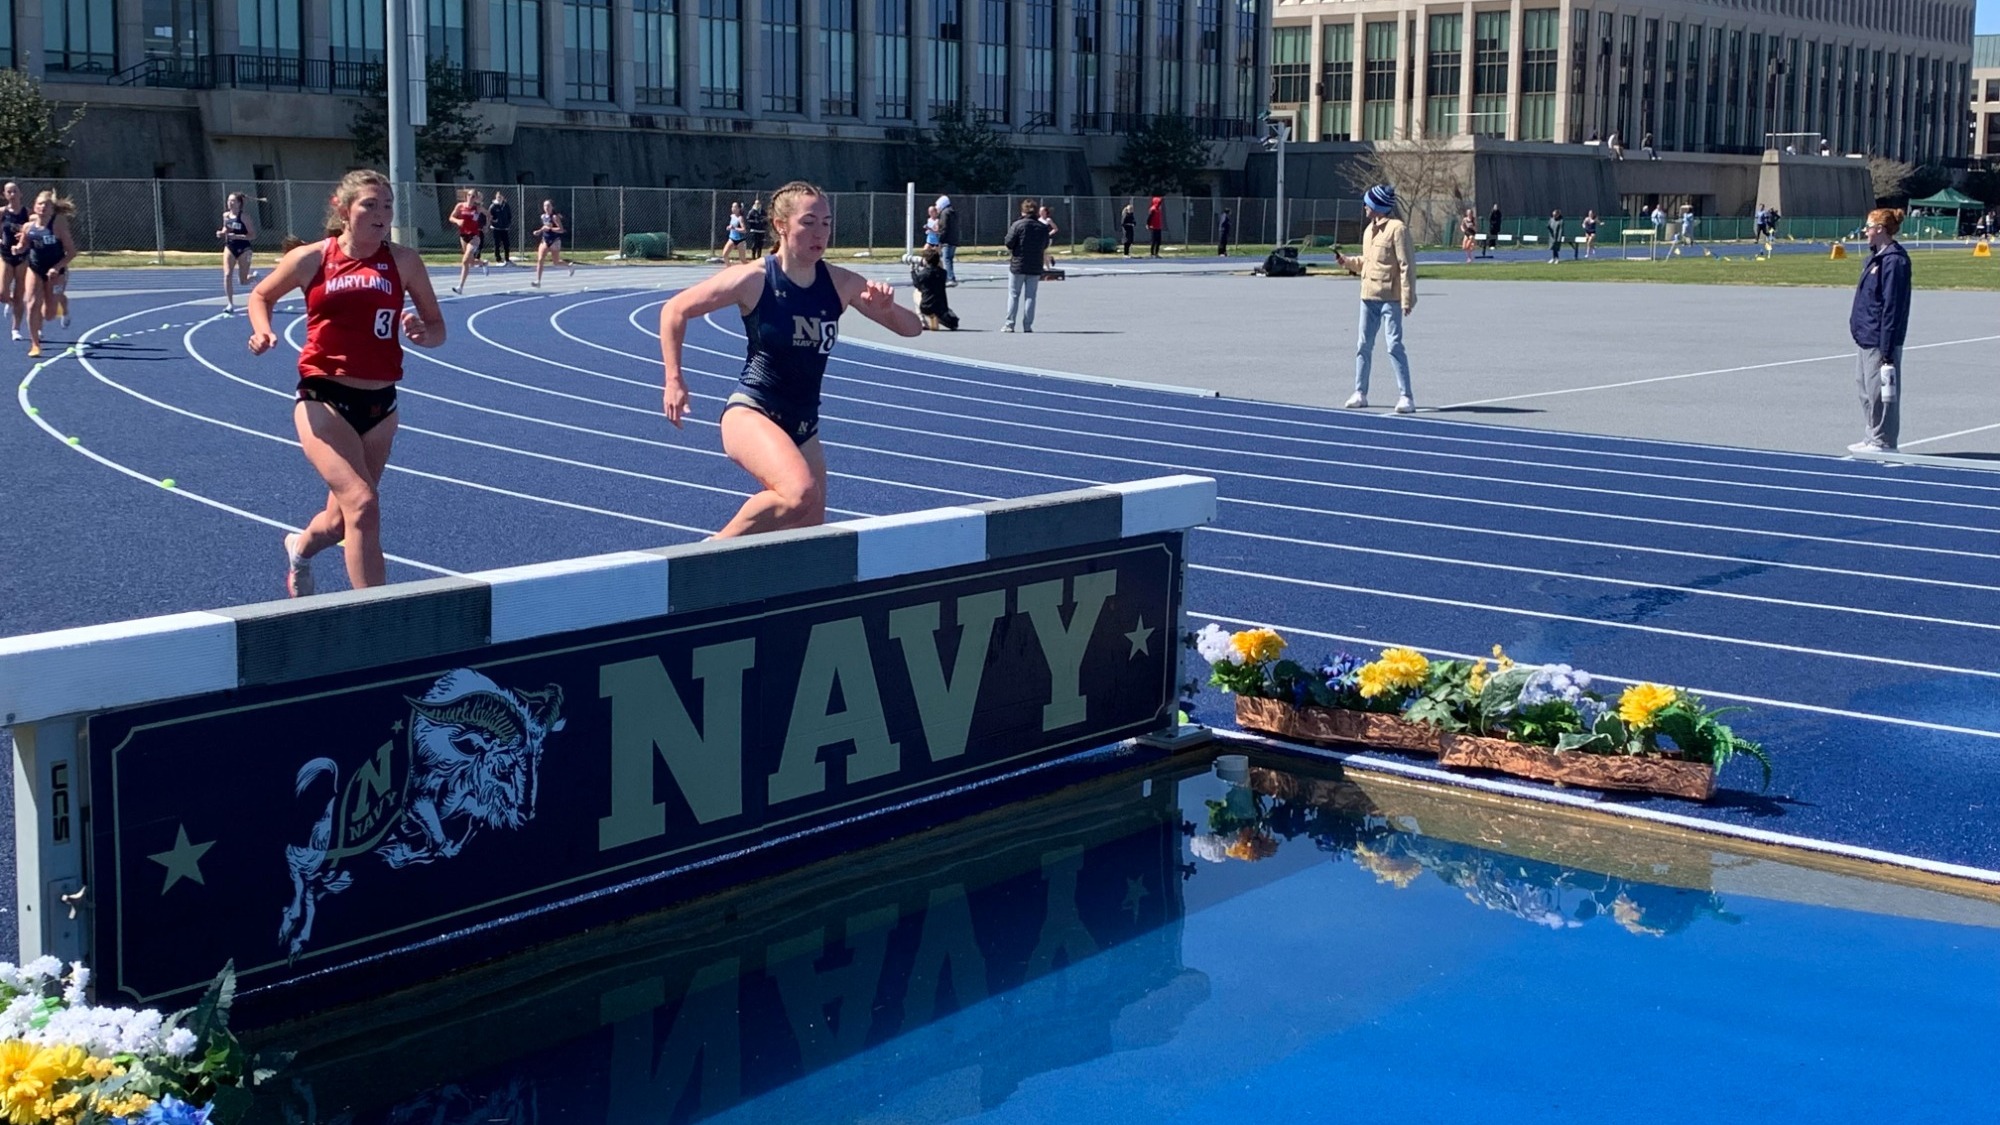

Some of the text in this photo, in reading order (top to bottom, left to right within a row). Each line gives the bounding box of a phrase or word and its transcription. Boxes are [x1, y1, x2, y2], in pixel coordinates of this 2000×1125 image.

[325, 274, 392, 295] MARYLAND
[377, 311, 391, 337] 3
[792, 315, 821, 341] N
[823, 324, 836, 352] 8
[792, 339, 819, 348] NAVY
[599, 569, 1117, 852] NAVY
[351, 739, 394, 823] N
[51, 763, 70, 841] UCS
[349, 791, 398, 841] NAVY
